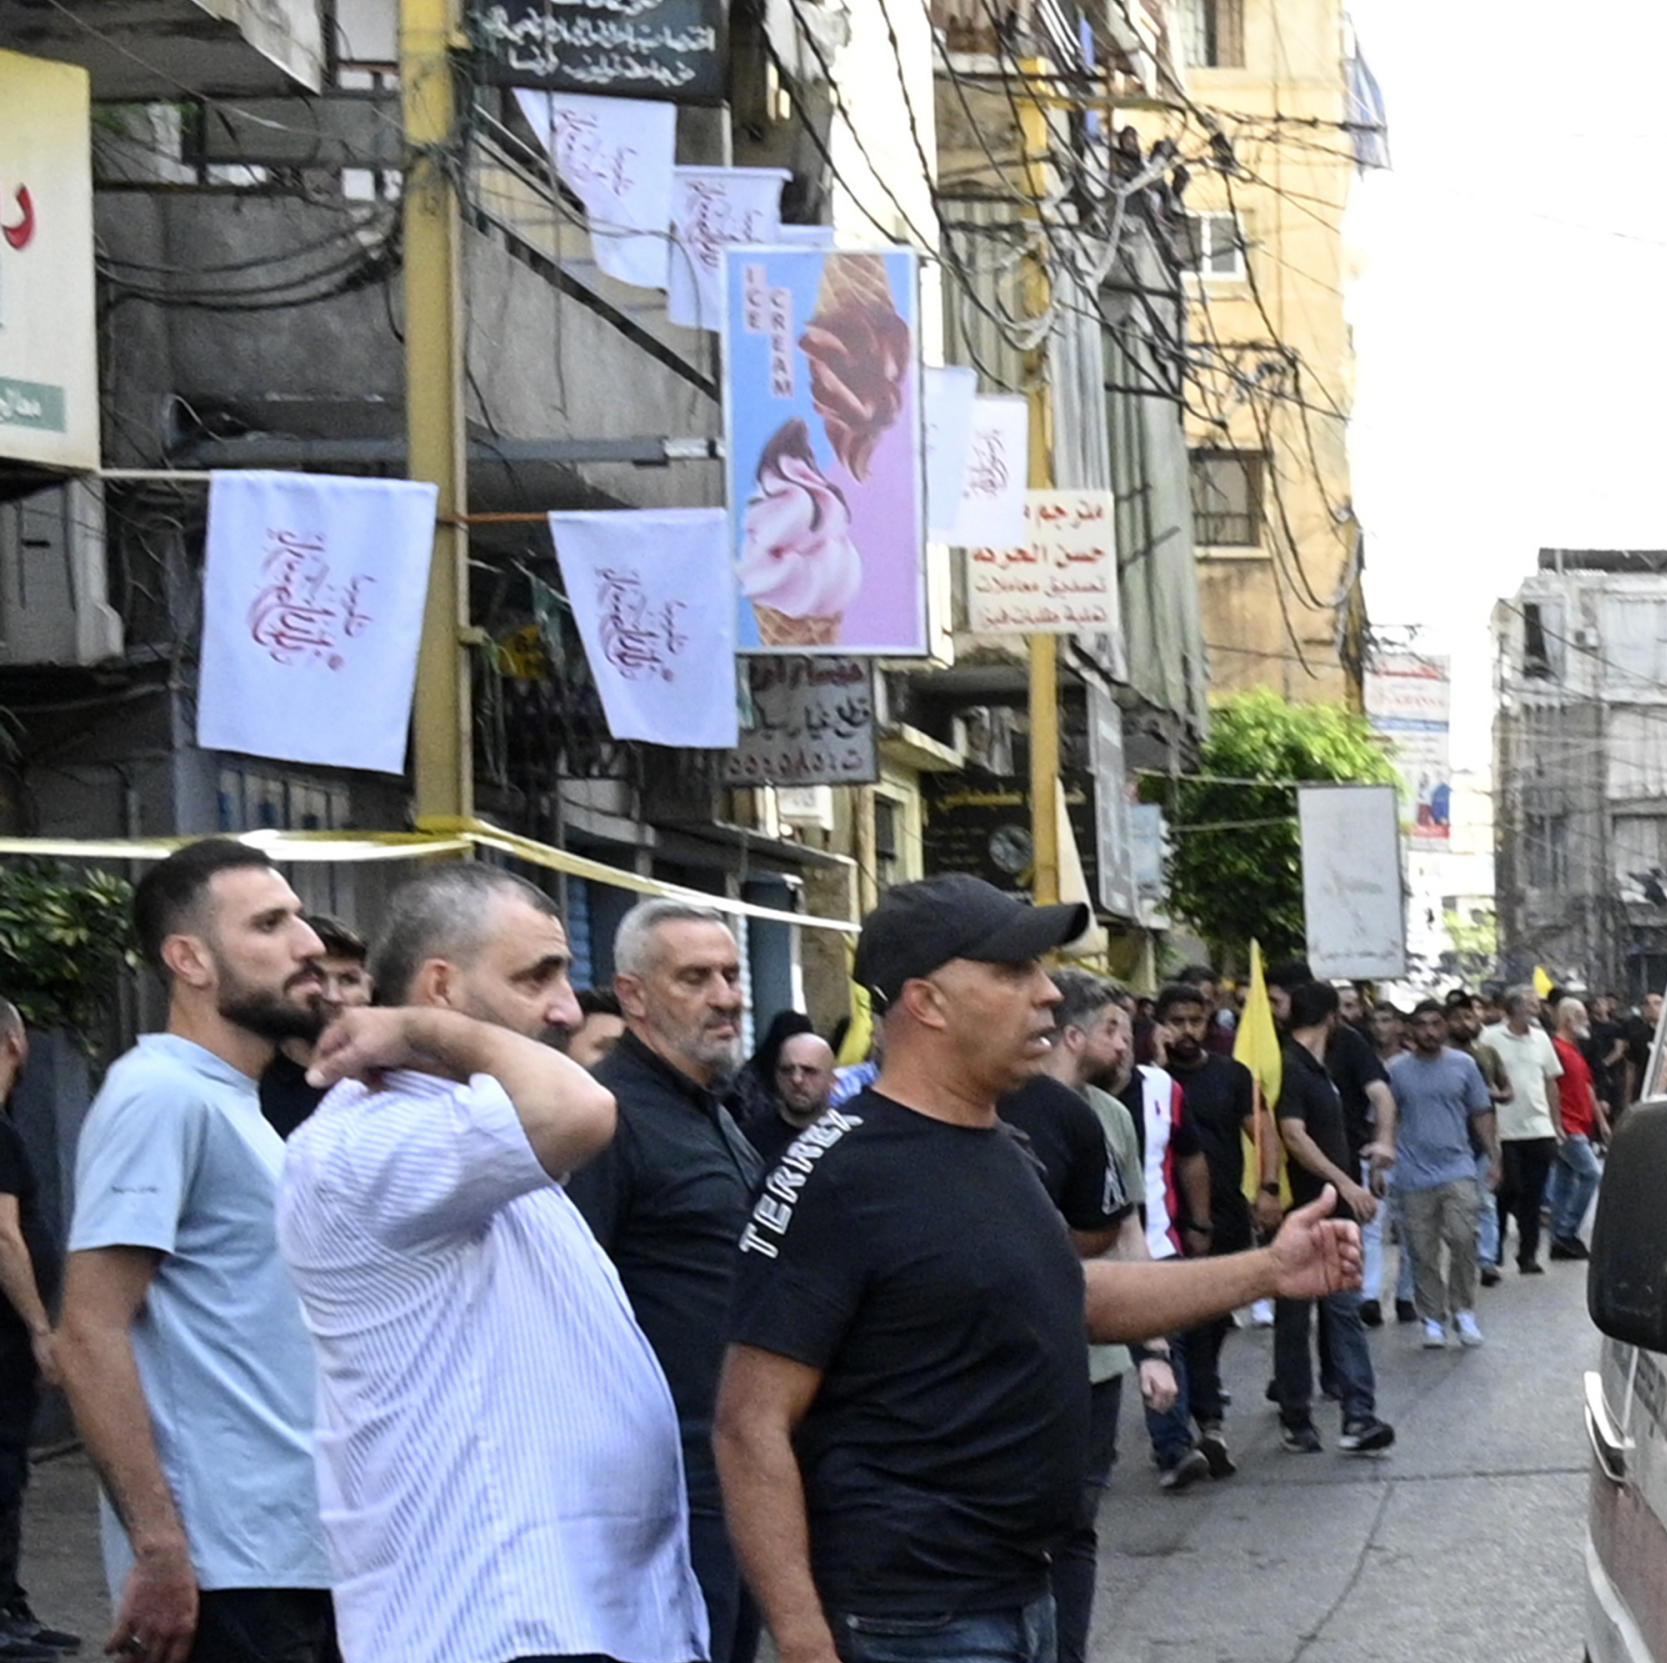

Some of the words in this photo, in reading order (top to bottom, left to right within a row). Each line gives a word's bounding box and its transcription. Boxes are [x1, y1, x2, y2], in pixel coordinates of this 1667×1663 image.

[745, 266, 762, 330] ICE
[770, 288, 794, 398] CREAM
[738, 1107, 864, 1259] TERREX
